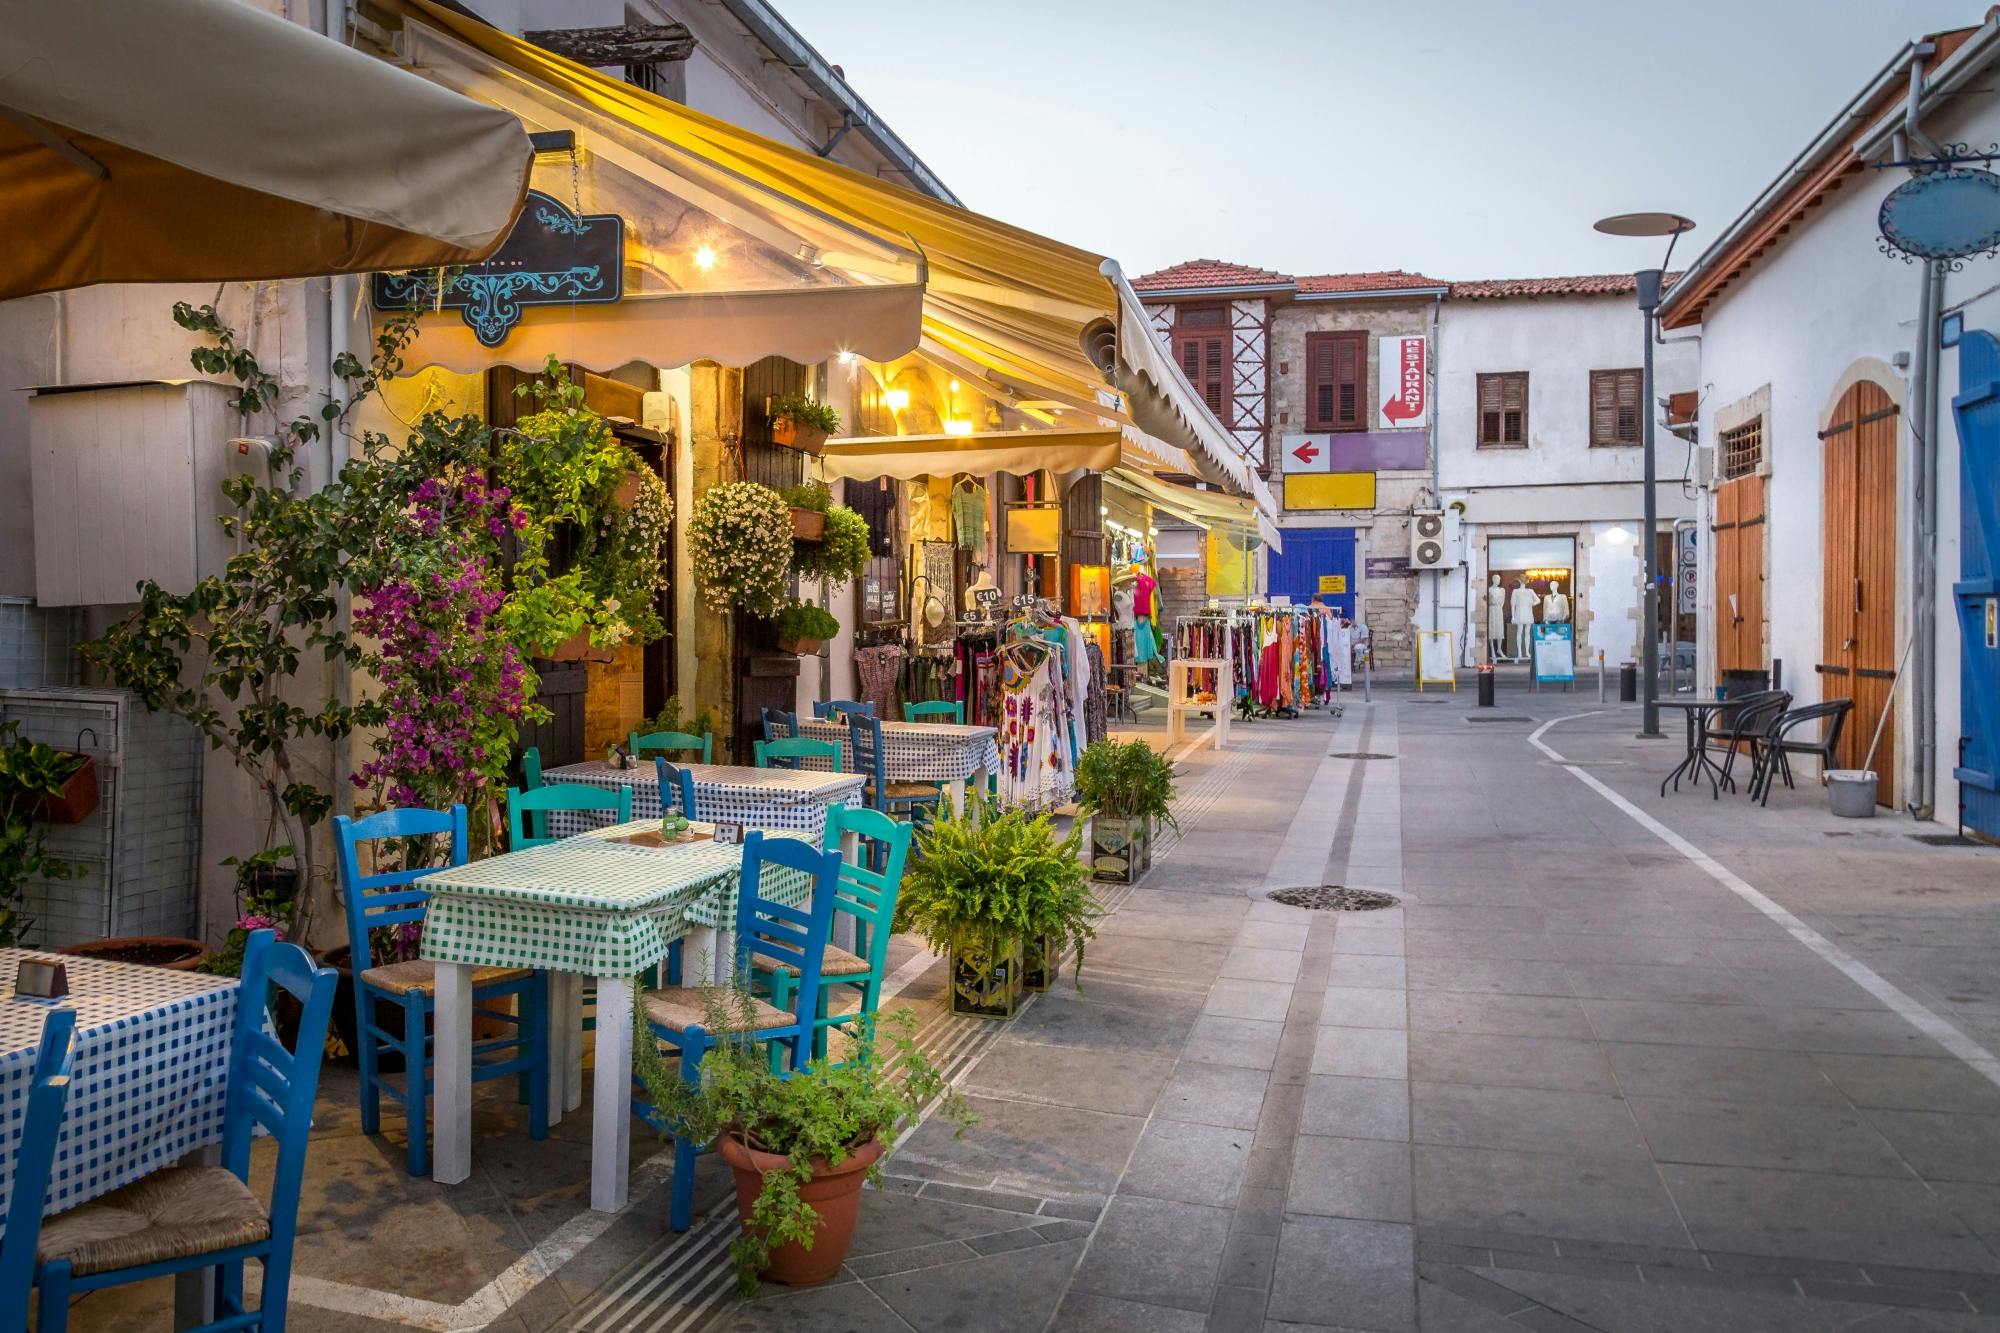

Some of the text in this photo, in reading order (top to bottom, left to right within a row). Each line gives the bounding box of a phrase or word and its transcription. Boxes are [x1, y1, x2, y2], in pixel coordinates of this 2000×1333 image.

[1405, 340, 1420, 411] RESTAURANT
[976, 591, 996, 602] €10
[1013, 595, 1034, 606] €15
[963, 612, 976, 621] €5
